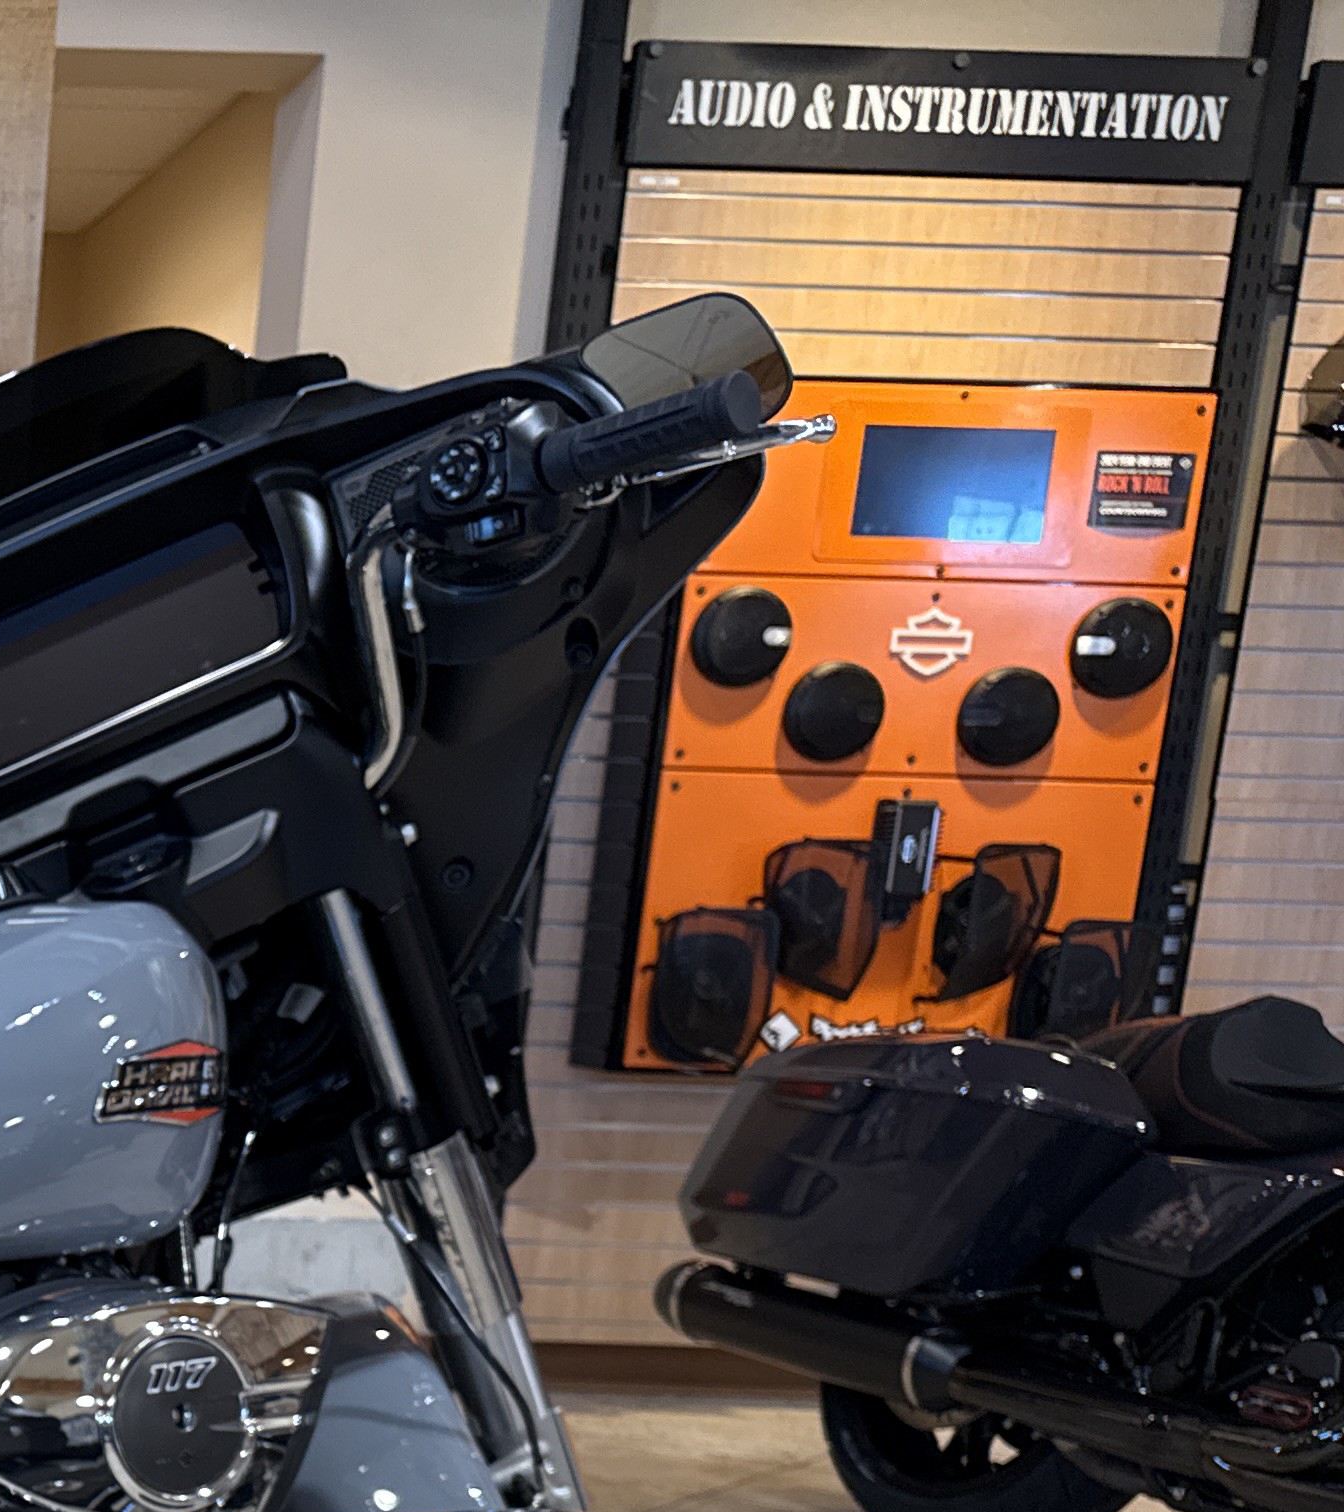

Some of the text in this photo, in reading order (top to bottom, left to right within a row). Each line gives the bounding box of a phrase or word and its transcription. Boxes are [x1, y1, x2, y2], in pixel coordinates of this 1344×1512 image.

[668, 80, 1229, 141] AUDIO & INSTRUMENTATION
[146, 1356, 217, 1395] 117
